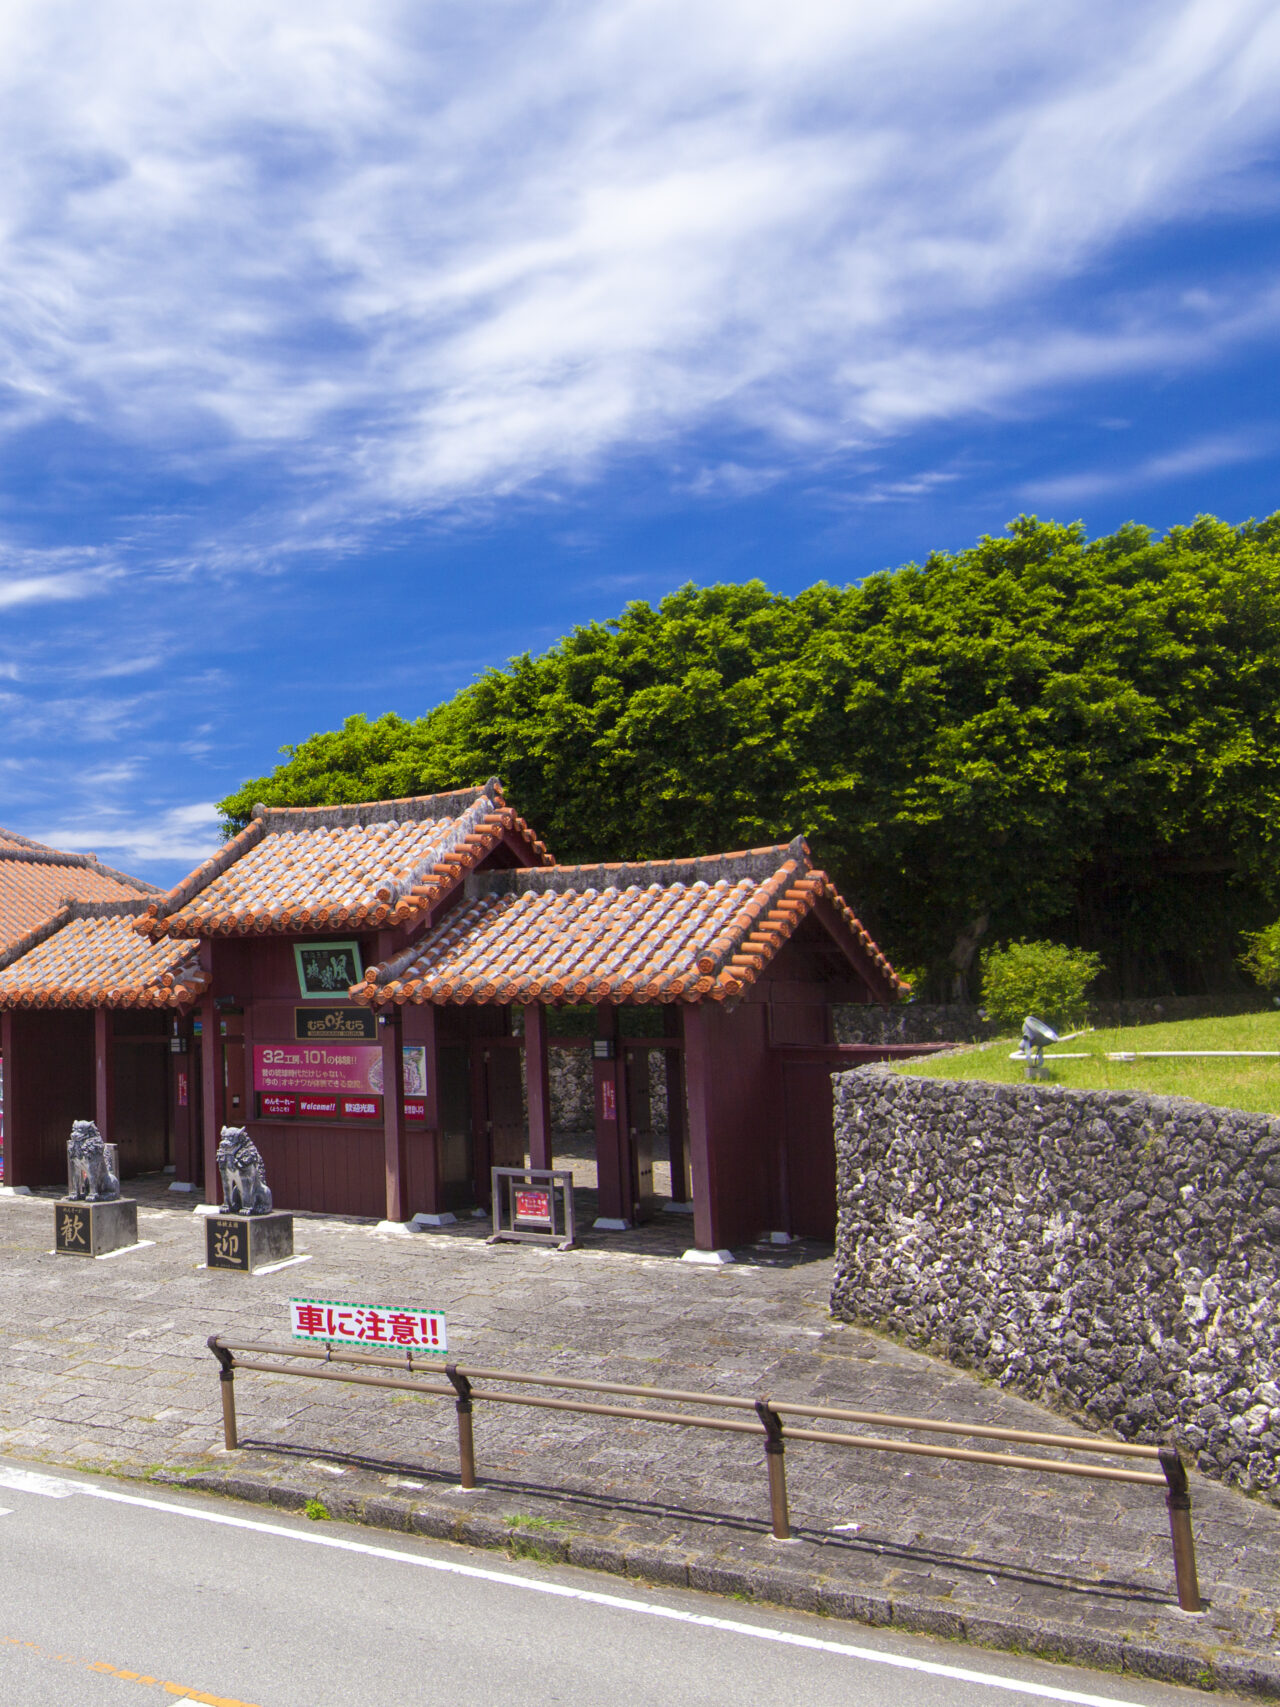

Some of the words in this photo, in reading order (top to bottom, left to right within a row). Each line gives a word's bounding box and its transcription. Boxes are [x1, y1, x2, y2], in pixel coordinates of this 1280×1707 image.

[307, 1011, 364, 1031] むら咲むら
[300, 1101, 336, 1112] Welcome!!
[214, 1229, 242, 1264] 迎
[296, 1305, 439, 1345] 車に注意!!
